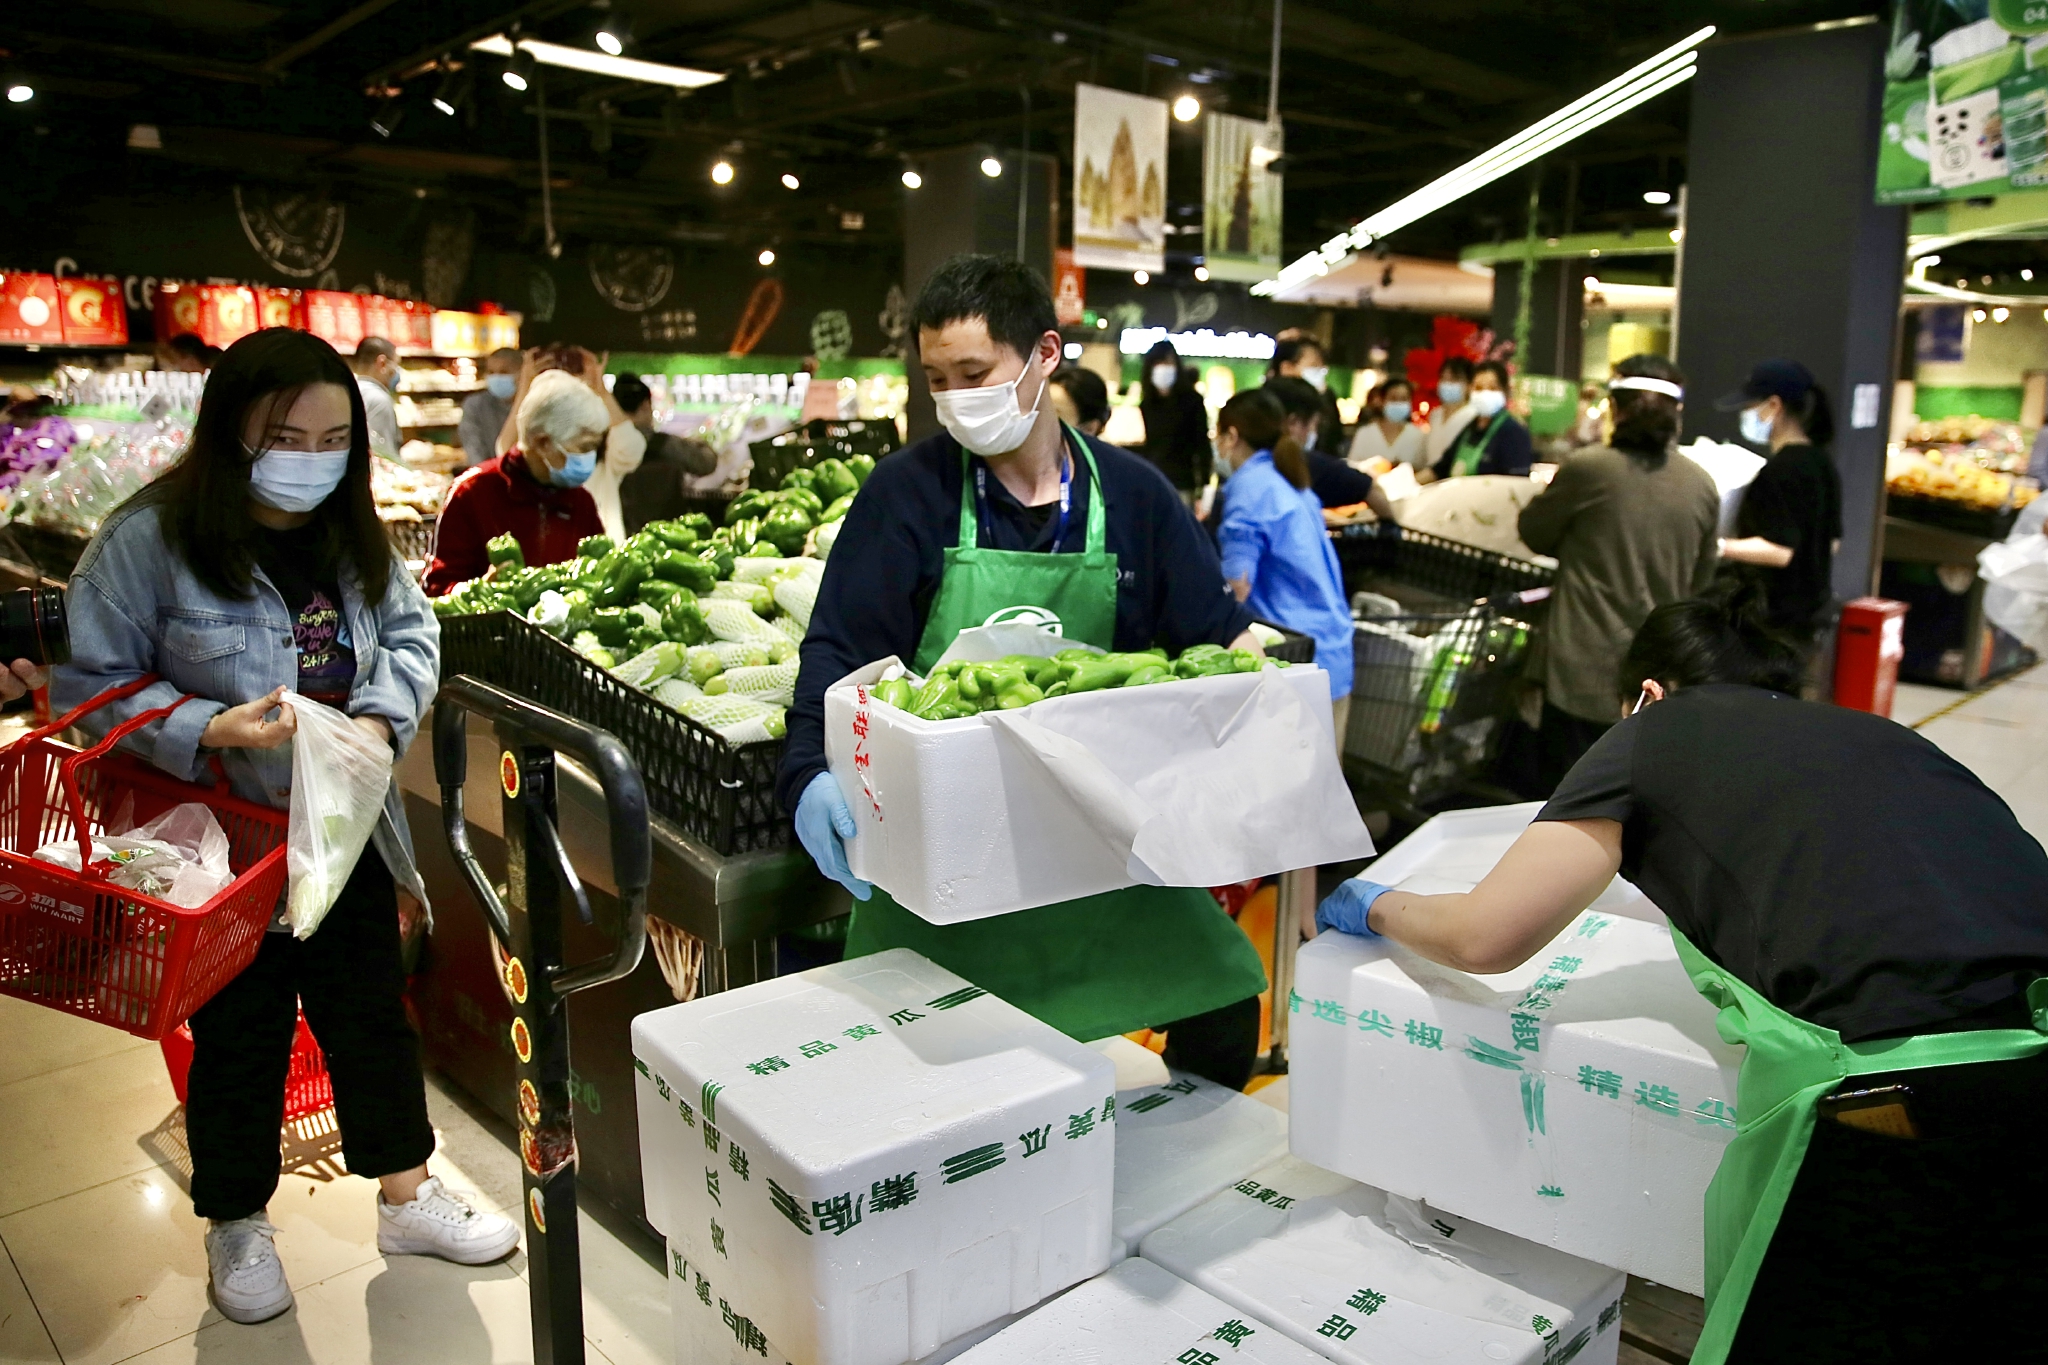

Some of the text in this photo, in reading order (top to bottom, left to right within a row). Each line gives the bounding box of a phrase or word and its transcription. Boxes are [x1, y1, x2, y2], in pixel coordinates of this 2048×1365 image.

[302, 653, 330, 668] 24/7
[51, 908, 83, 925] MART
[746, 1008, 926, 1076] 精品黄瓜
